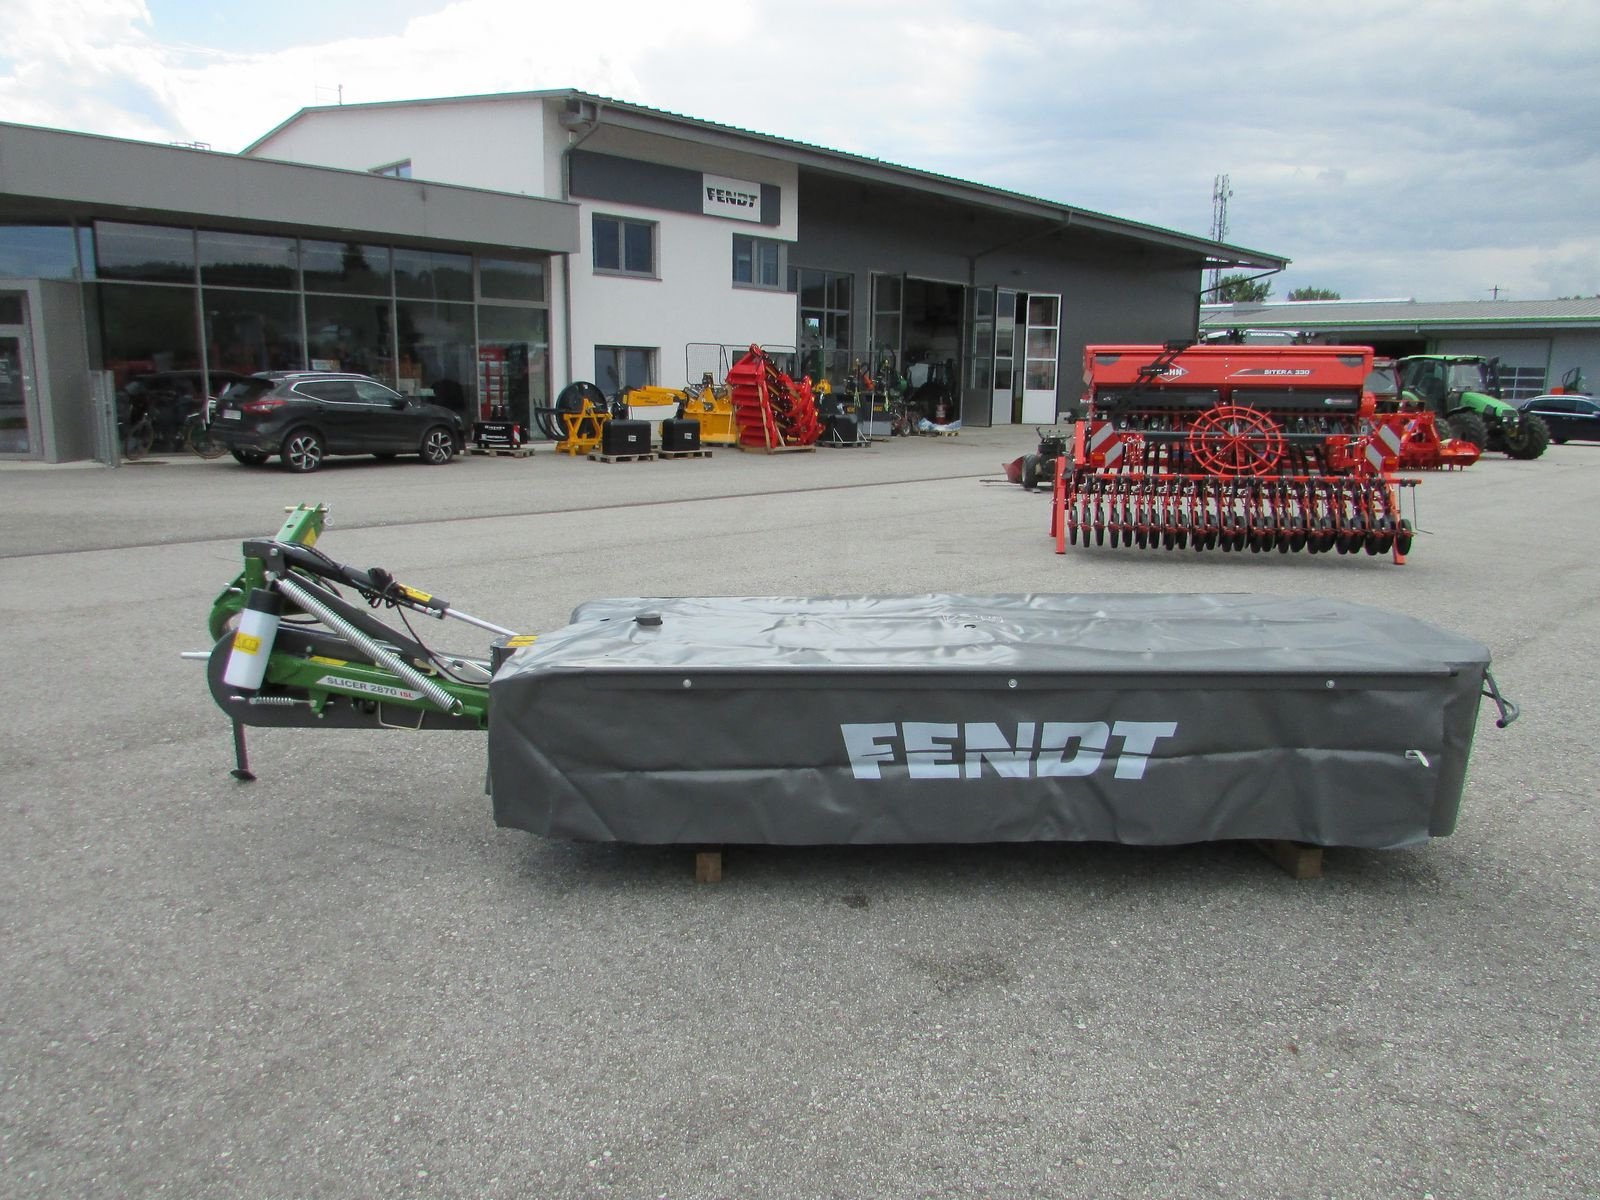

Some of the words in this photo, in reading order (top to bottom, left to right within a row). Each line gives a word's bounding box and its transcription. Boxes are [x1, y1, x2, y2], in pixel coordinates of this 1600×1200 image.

[706, 187, 758, 208] FENDT
[327, 677, 367, 690] SLICER
[370, 684, 397, 695] 2870
[399, 690, 414, 699] ISL
[840, 720, 1178, 780] FENDT
